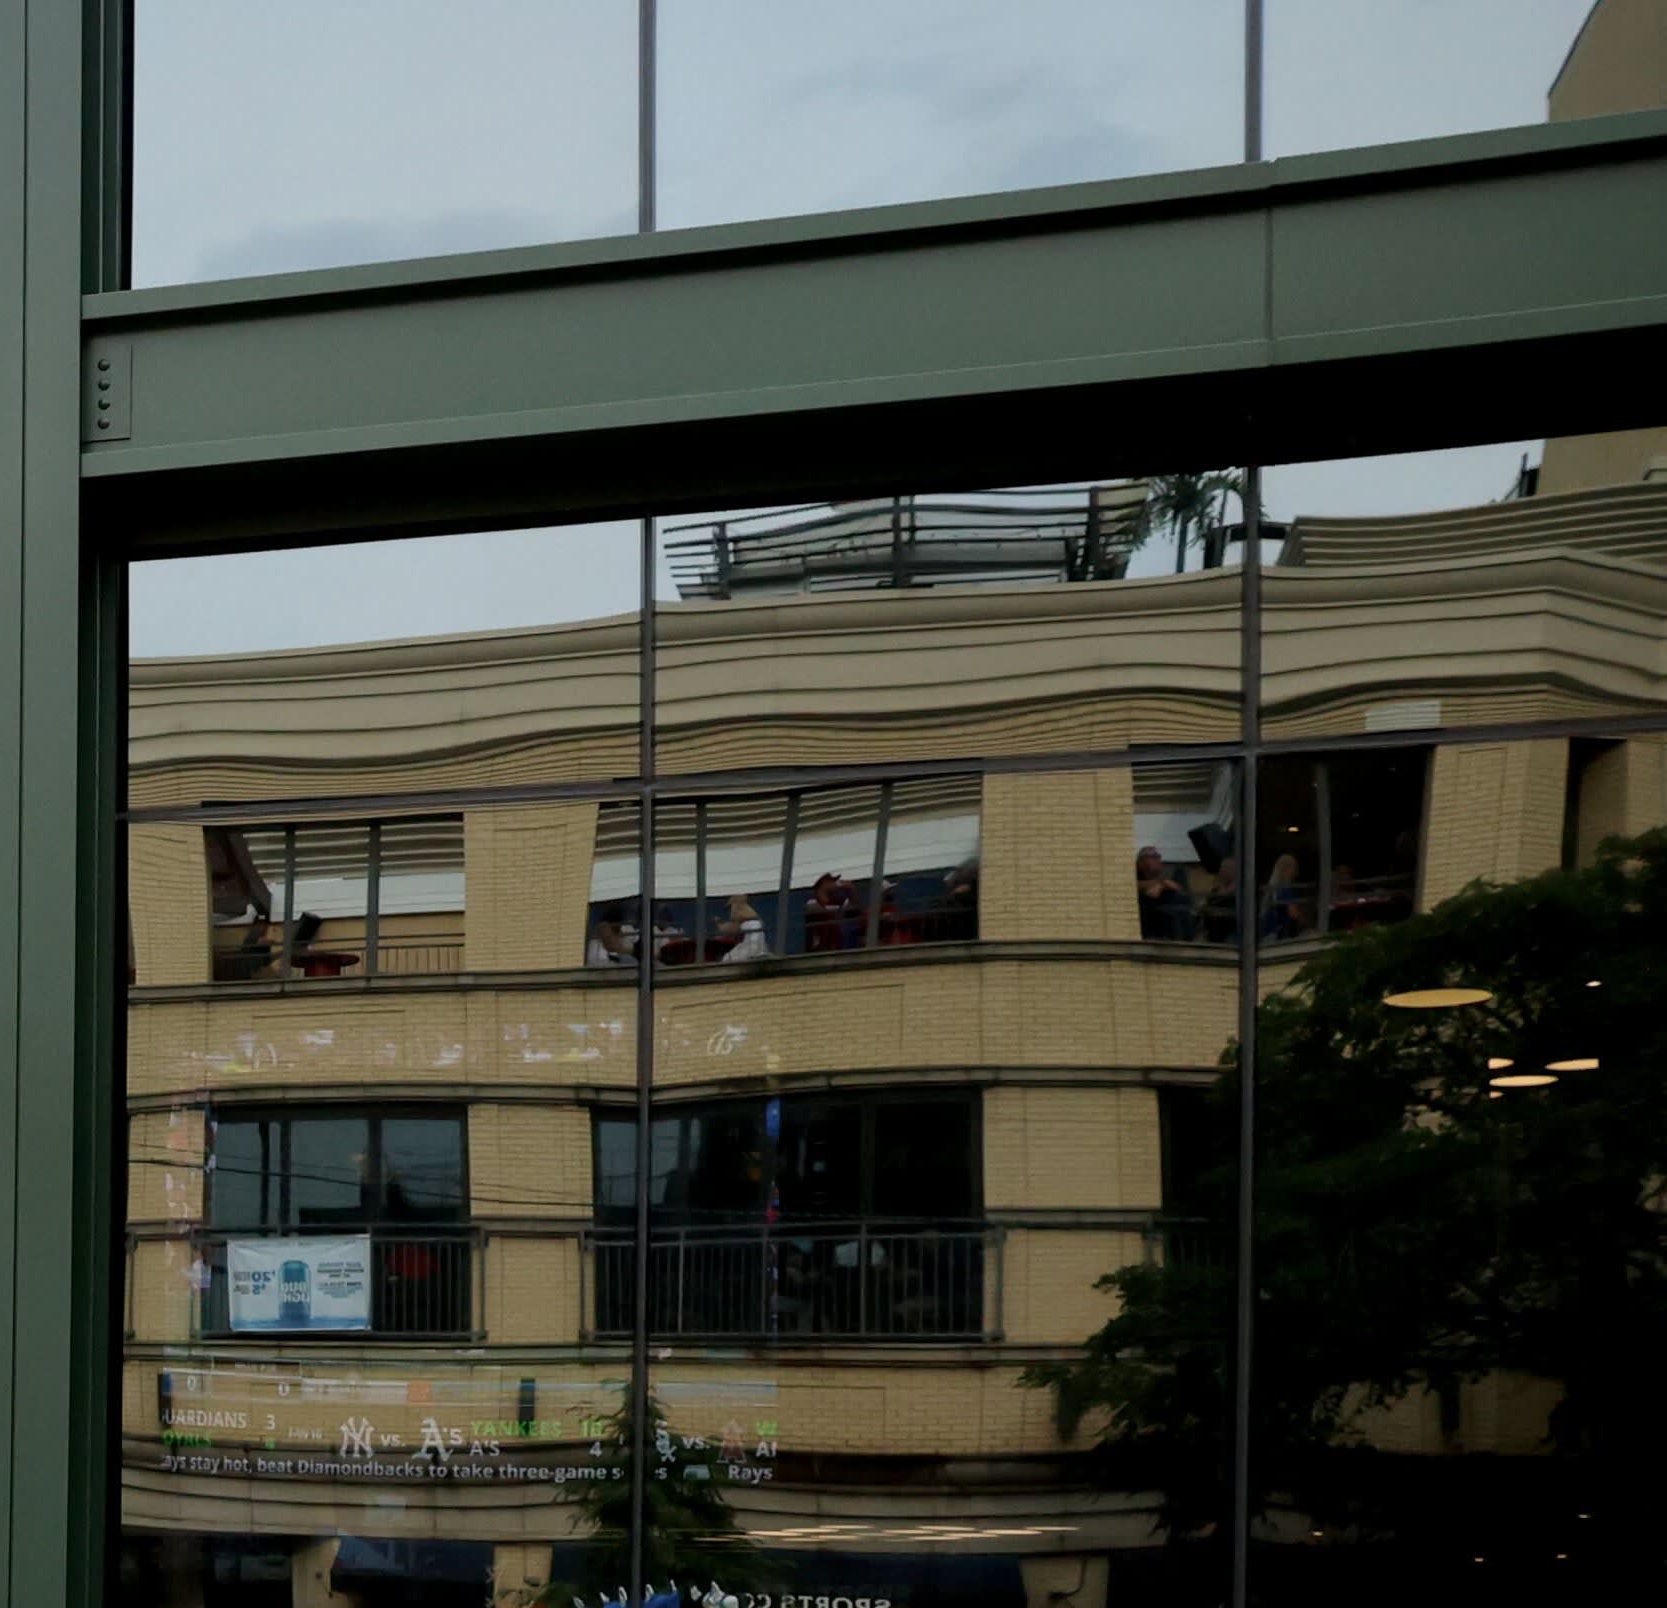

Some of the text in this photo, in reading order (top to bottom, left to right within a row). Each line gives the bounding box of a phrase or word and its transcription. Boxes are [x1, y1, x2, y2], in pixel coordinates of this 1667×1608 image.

[163, 1456, 187, 1472] ays
[257, 1458, 293, 1473] beat
[298, 1459, 423, 1478] Diamondbacks
[428, 1465, 447, 1478] to
[453, 1463, 494, 1479] take
[498, 1463, 607, 1483] three-game
[728, 1464, 773, 1484] Rays
